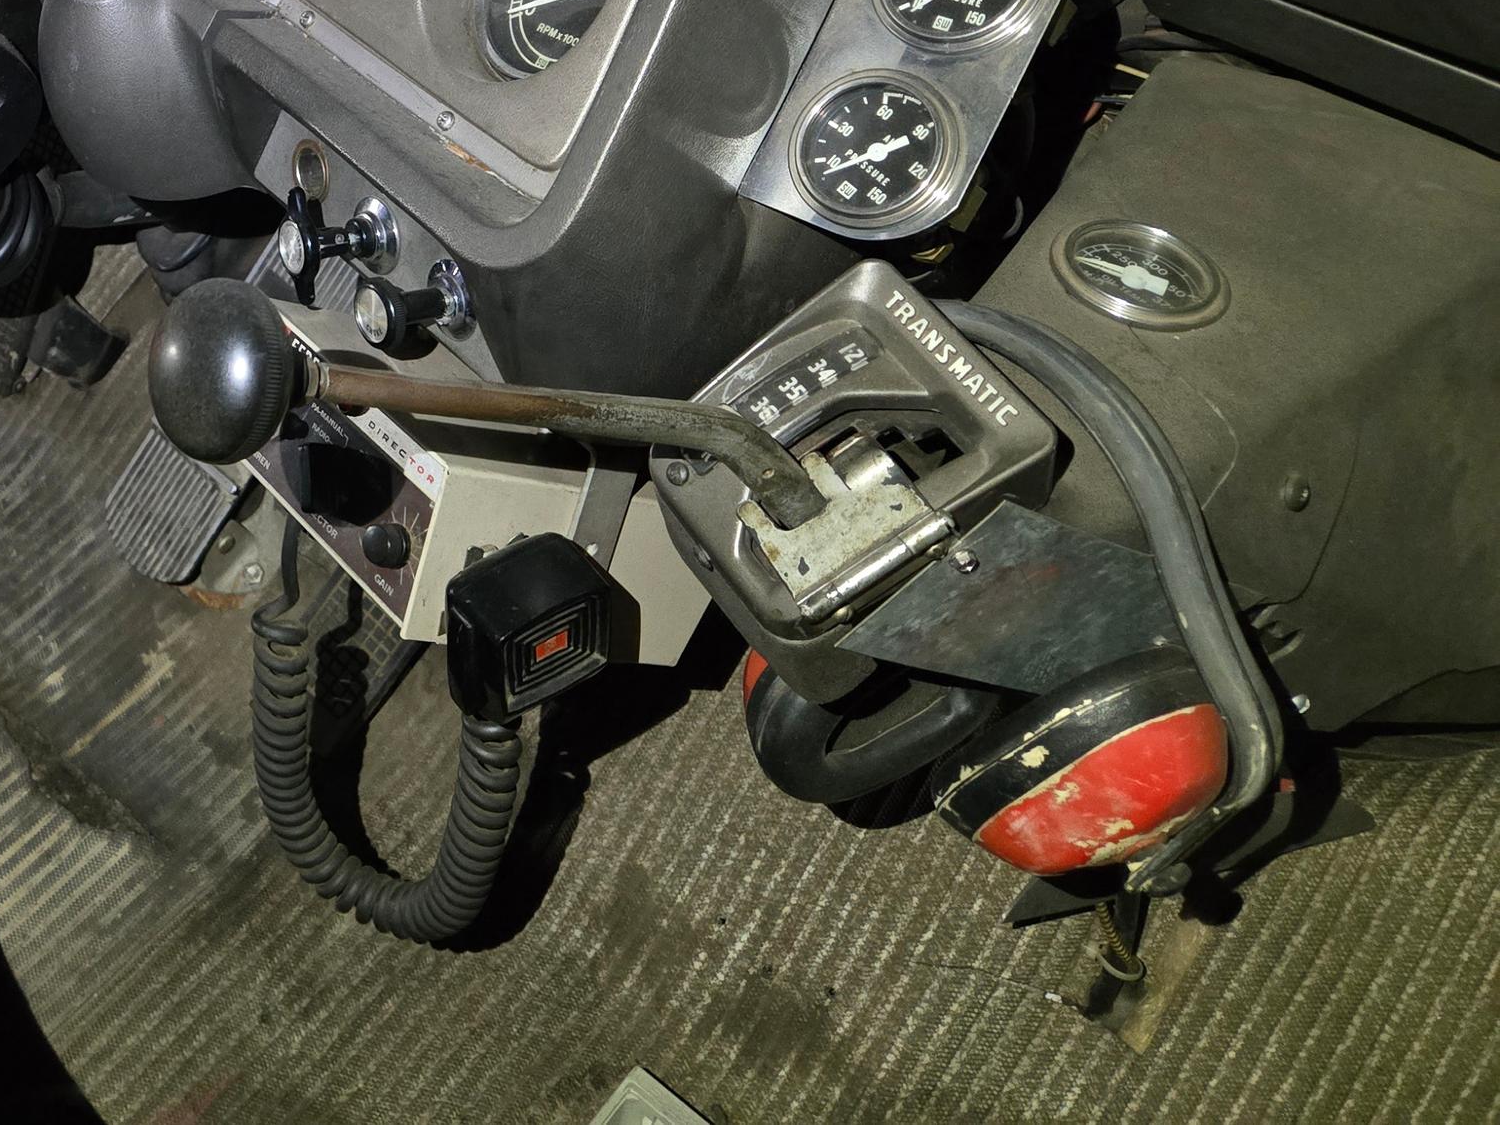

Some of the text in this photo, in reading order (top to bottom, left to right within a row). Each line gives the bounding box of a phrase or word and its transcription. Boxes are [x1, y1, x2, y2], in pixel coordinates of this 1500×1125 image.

[964, 10, 986, 26] 150
[876, 104, 894, 120] 60
[837, 121, 854, 137] 30
[912, 124, 930, 141] 90
[826, 154, 842, 169] 10
[908, 161, 928, 180] 120
[866, 186, 887, 205] 150
[1111, 250, 1138, 267] 250
[1142, 258, 1168, 276] 300
[885, 290, 1019, 427] TRANSMATIC
[310, 402, 345, 437] PA-MANUAL
[311, 422, 330, 443] RADIO
[367, 420, 435, 484] DIRECTOR
[373, 573, 394, 597] GAIN
